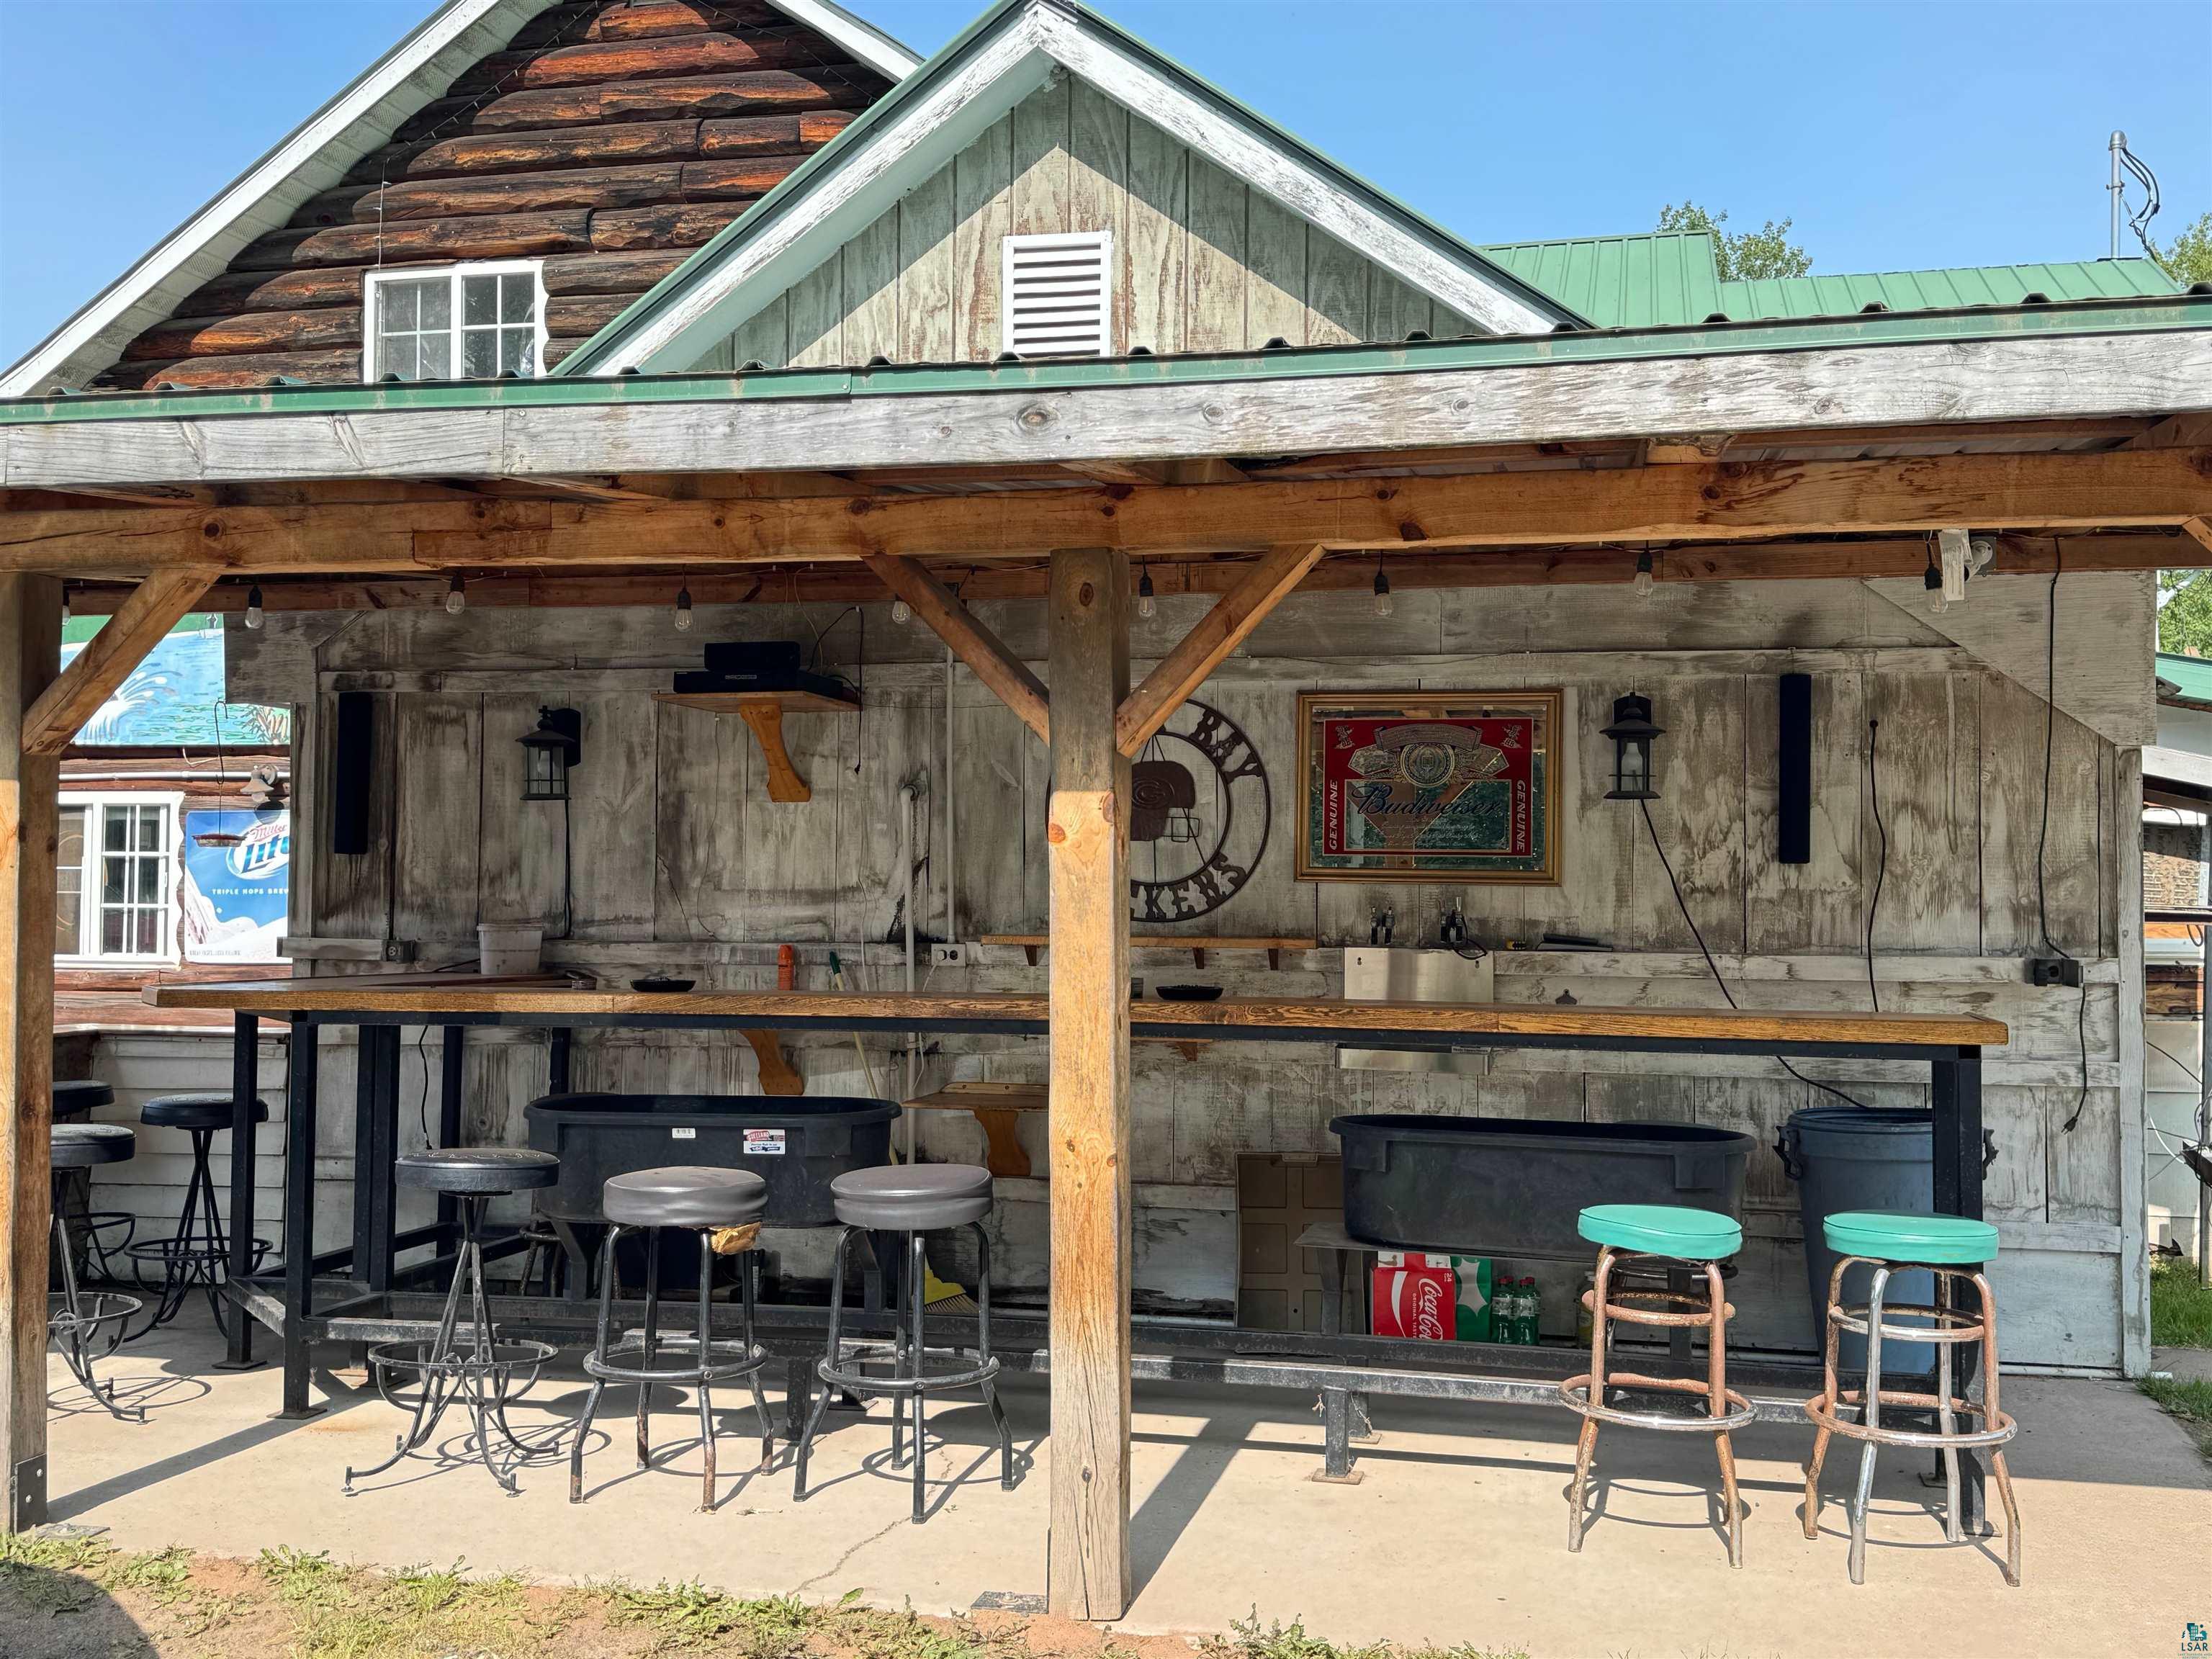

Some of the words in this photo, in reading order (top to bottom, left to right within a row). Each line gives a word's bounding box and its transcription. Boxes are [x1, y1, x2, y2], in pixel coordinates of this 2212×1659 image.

[1187, 709, 1262, 785] BAY
[248, 824, 287, 841] Miller
[1329, 779, 1338, 850] GENUINE
[1351, 783, 1502, 815] Budweiser
[1516, 780, 1526, 853] GENUINE
